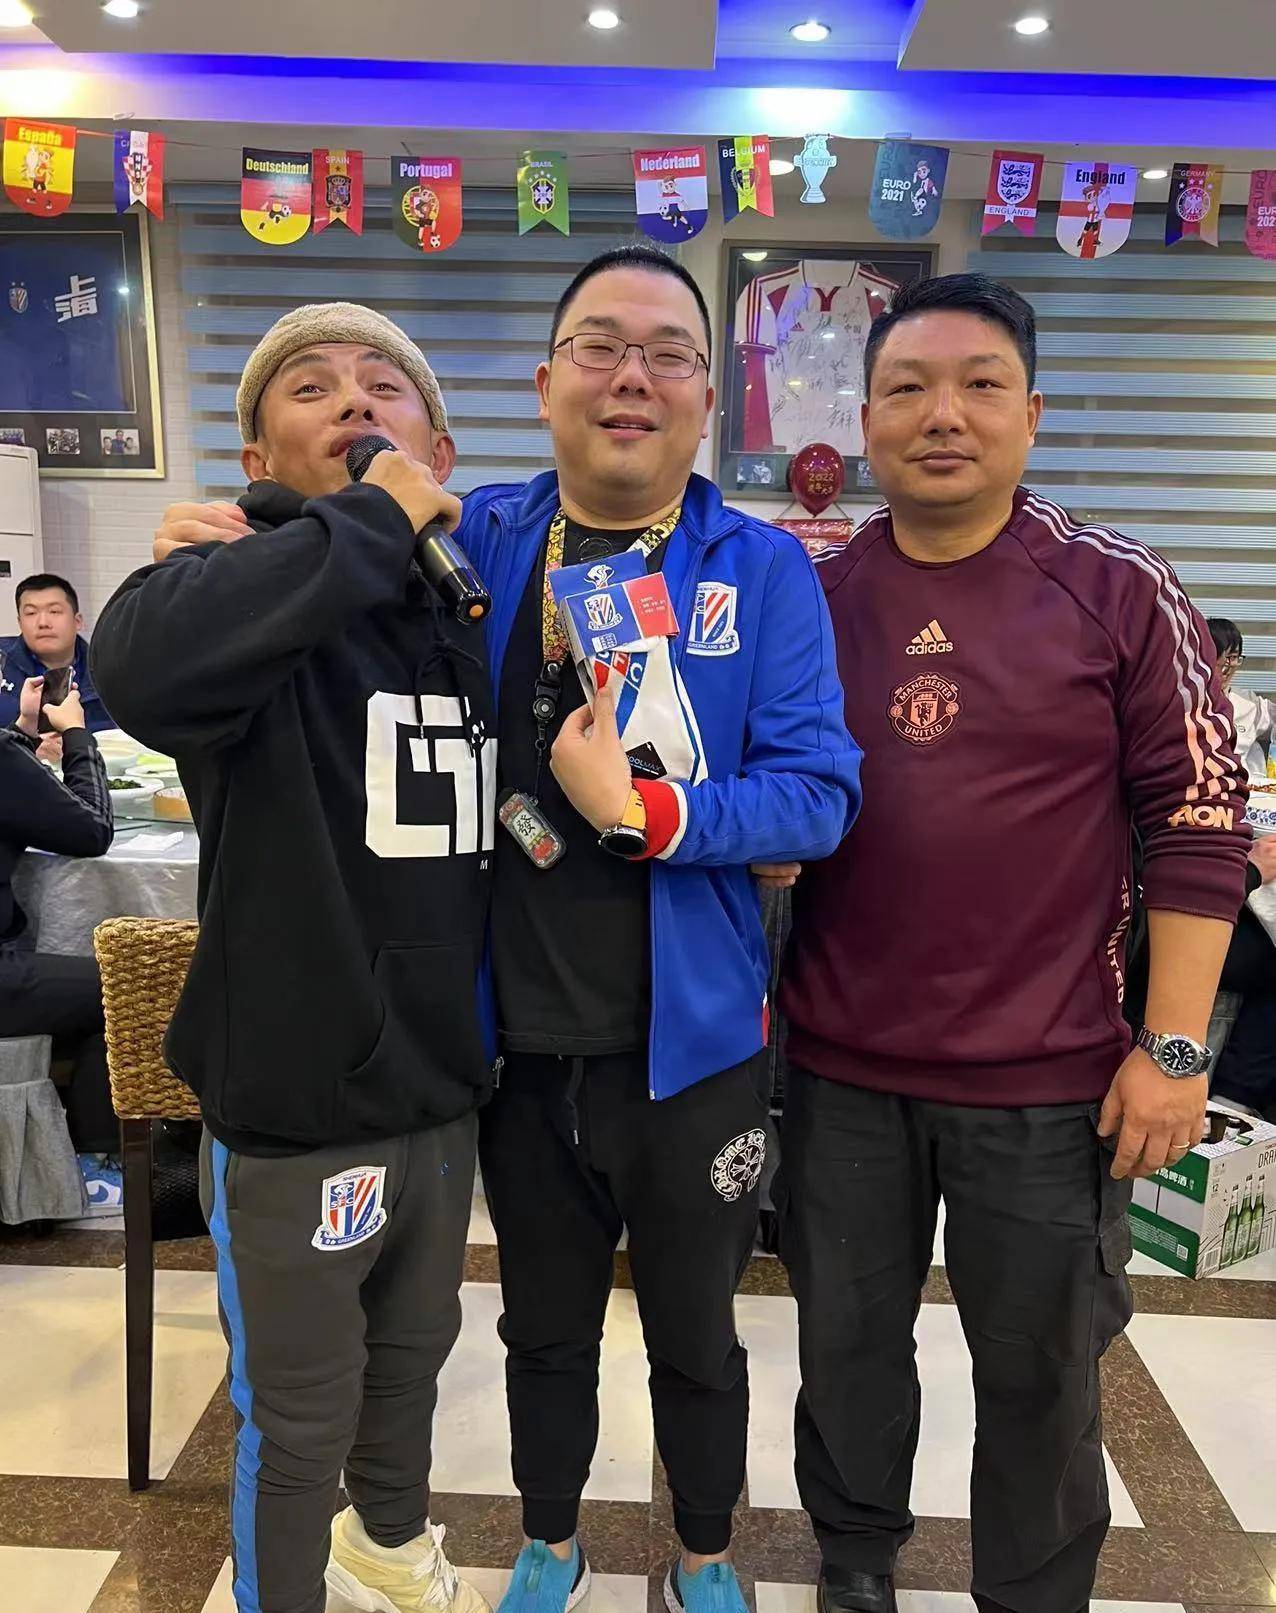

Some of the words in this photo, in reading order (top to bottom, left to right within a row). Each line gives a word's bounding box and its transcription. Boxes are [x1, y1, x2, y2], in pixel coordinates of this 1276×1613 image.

[18, 127, 62, 146] España
[722, 144, 766, 158] BELGIUM
[246, 157, 309, 175] Deutschland
[325, 155, 350, 164] SPAIN
[640, 153, 700, 172] Nederland
[400, 162, 453, 178] Portugal
[1180, 169, 1214, 177] GERMANY
[882, 179, 911, 190] EURO
[1076, 169, 1126, 186] England
[881, 189, 904, 201] 2021
[989, 207, 1030, 216] ENGLAND
[808, 473, 835, 482] 2022
[905, 641, 954, 655] adidas
[899, 679, 954, 701] MANCHESTER
[904, 724, 943, 737] UNITED
[1168, 804, 1234, 831] AON
[1107, 915, 1131, 1004] UNITED
